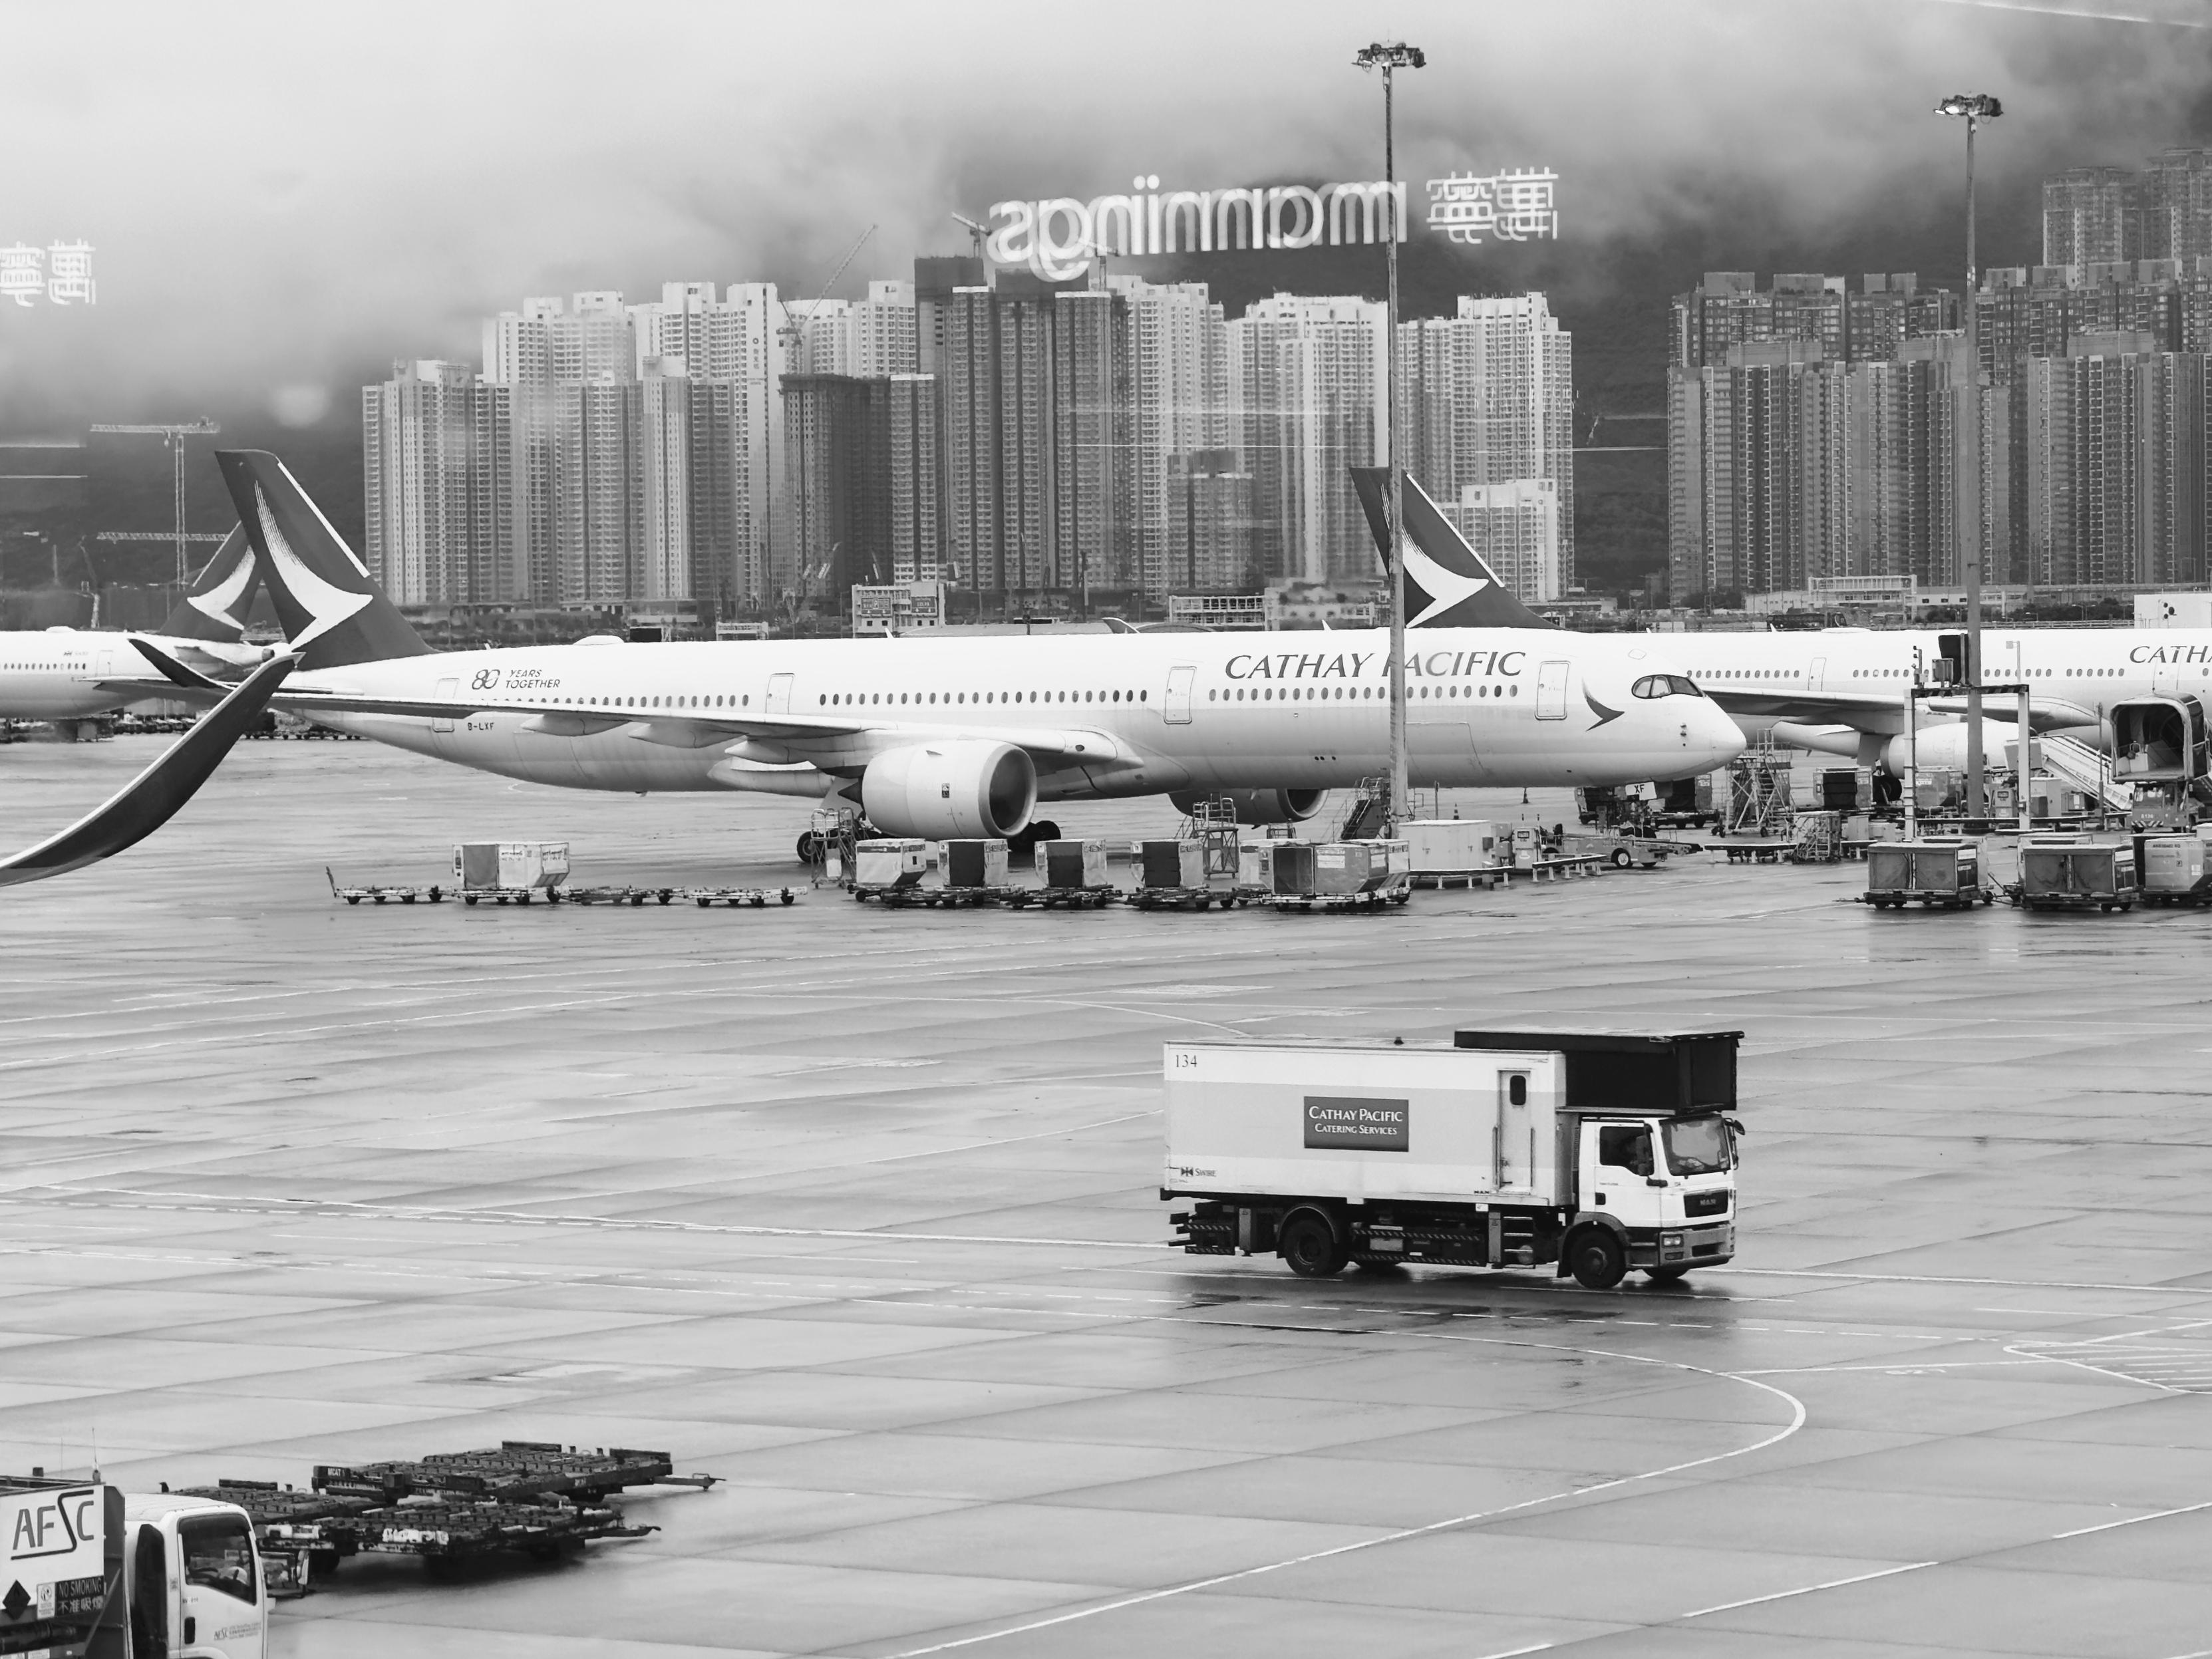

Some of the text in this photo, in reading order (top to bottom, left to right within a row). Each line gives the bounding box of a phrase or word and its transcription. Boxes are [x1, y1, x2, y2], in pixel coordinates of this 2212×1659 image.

[2130, 646, 2212, 663] CATH
[1225, 653, 1375, 679] CATHAY
[472, 669, 500, 690] 80
[506, 679, 560, 688] TOGETHER
[1634, 784, 1645, 793] XF
[1176, 1054, 1197, 1068] 134
[1309, 1106, 1403, 1122] CATHAY PACIFIC
[1315, 1123, 1398, 1135] CATERING SERVICES
[11, 1489, 94, 1561] AFSC
[59, 1577, 102, 1597] NO SMOKING
